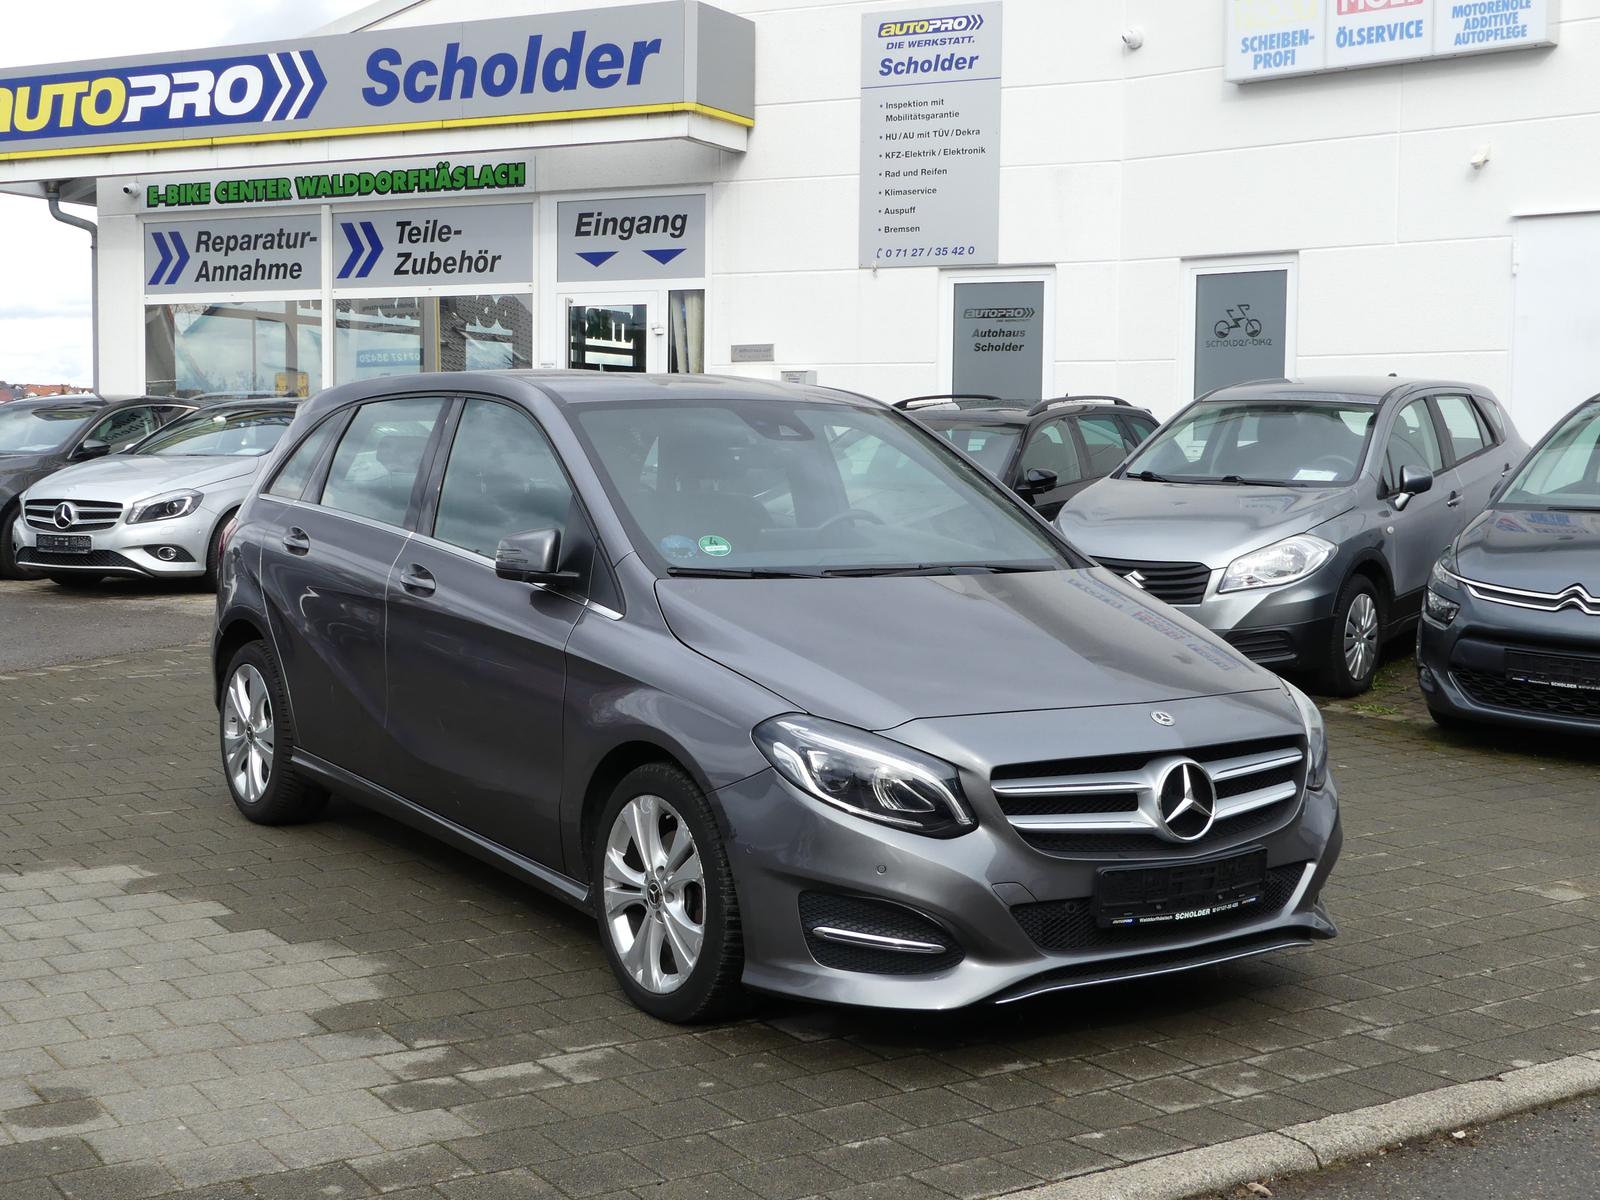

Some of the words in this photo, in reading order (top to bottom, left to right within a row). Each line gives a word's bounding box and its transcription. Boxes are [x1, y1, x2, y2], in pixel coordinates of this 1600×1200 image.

[1463, 12, 1519, 31] ADDITIVE
[886, 41, 905, 50] DIE
[908, 36, 975, 48] WERKSTATT.
[1241, 29, 1315, 53] SCHEIBEN-
[1336, 19, 1423, 48] ÖLSERVICE
[1454, 24, 1528, 45] AUTOPFLEGE
[361, 30, 662, 107] Scholder
[879, 53, 979, 76] Scholder
[1253, 49, 1296, 70] PROFI
[886, 100, 928, 110] Inspektion
[931, 98, 945, 106] mit
[886, 110, 960, 122] Mobilitätsgarantie
[917, 131, 930, 139] mit
[884, 170, 901, 178] Rad
[903, 169, 918, 177] und
[921, 168, 948, 176] Reifen
[147, 181, 211, 208] E-BIKE
[214, 177, 293, 204] CENTER
[294, 161, 526, 200] WALDDORFHÄSLACH
[884, 187, 937, 196] Klimaservice
[884, 206, 916, 215] Auspuff
[396, 219, 462, 244] Teile-
[574, 211, 688, 241] Eingang
[884, 225, 920, 233] Bremsen
[195, 228, 318, 257] Reparatur-
[194, 258, 303, 283] Annahme
[393, 249, 502, 276] Zubehör
[972, 328, 1026, 338] Autohaus
[974, 342, 1025, 352] Scholder
[1174, 908, 1211, 920] SCHOLDER
